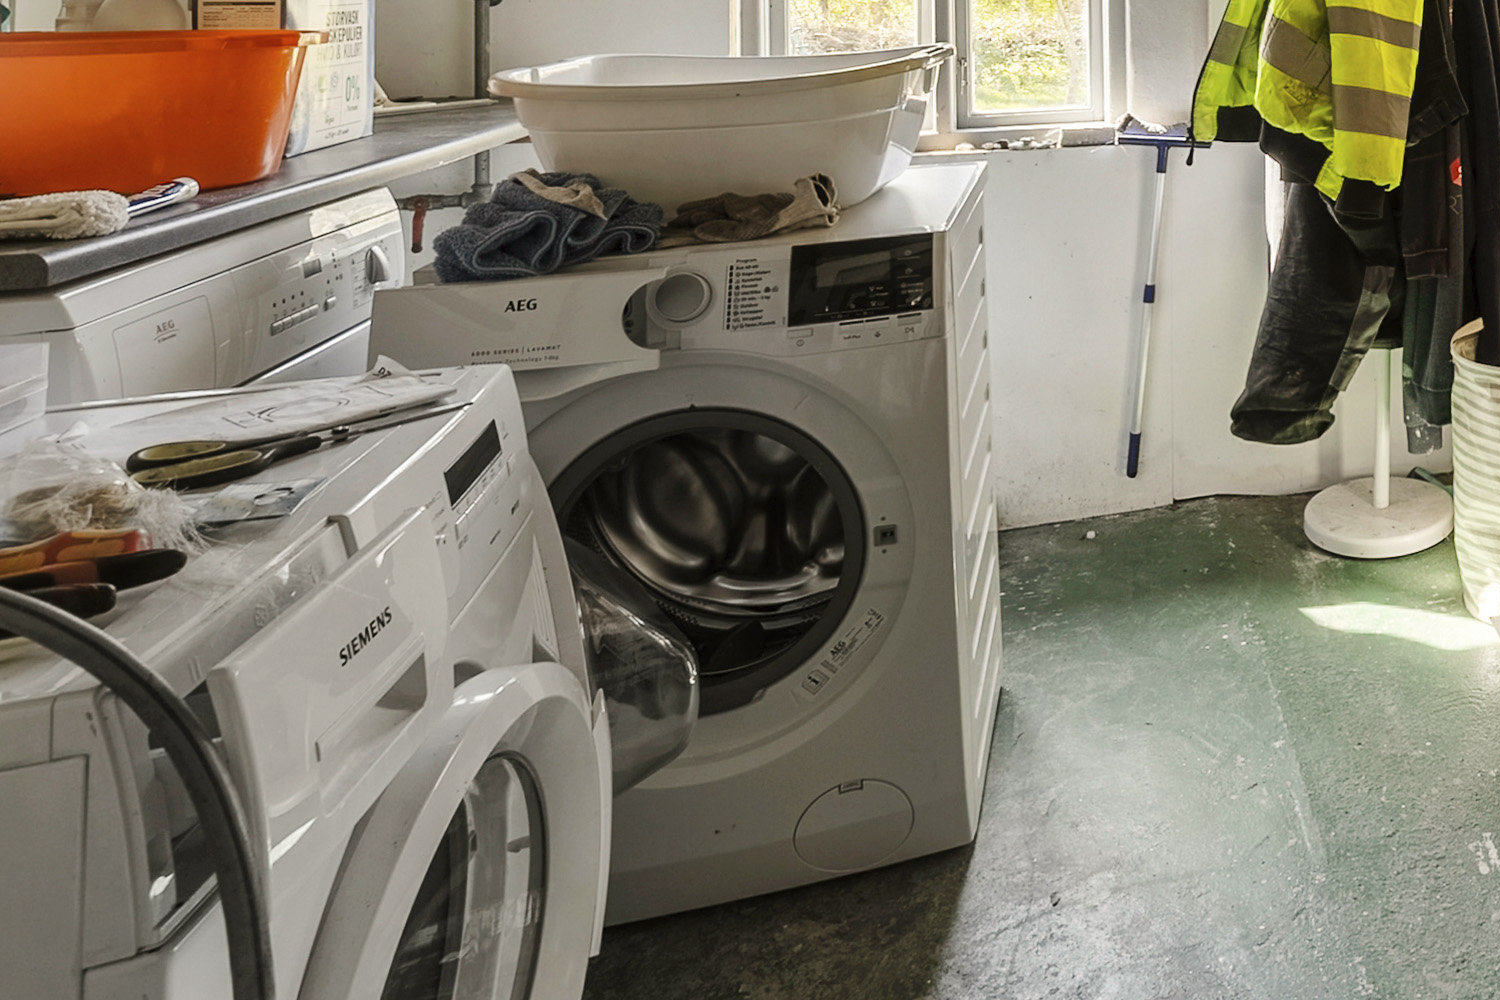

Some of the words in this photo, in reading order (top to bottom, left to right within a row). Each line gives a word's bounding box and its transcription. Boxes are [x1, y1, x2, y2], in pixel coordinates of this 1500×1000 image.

[504, 298, 538, 314] AEG
[156, 319, 176, 335] AEG
[339, 605, 392, 667] SIEMENS
